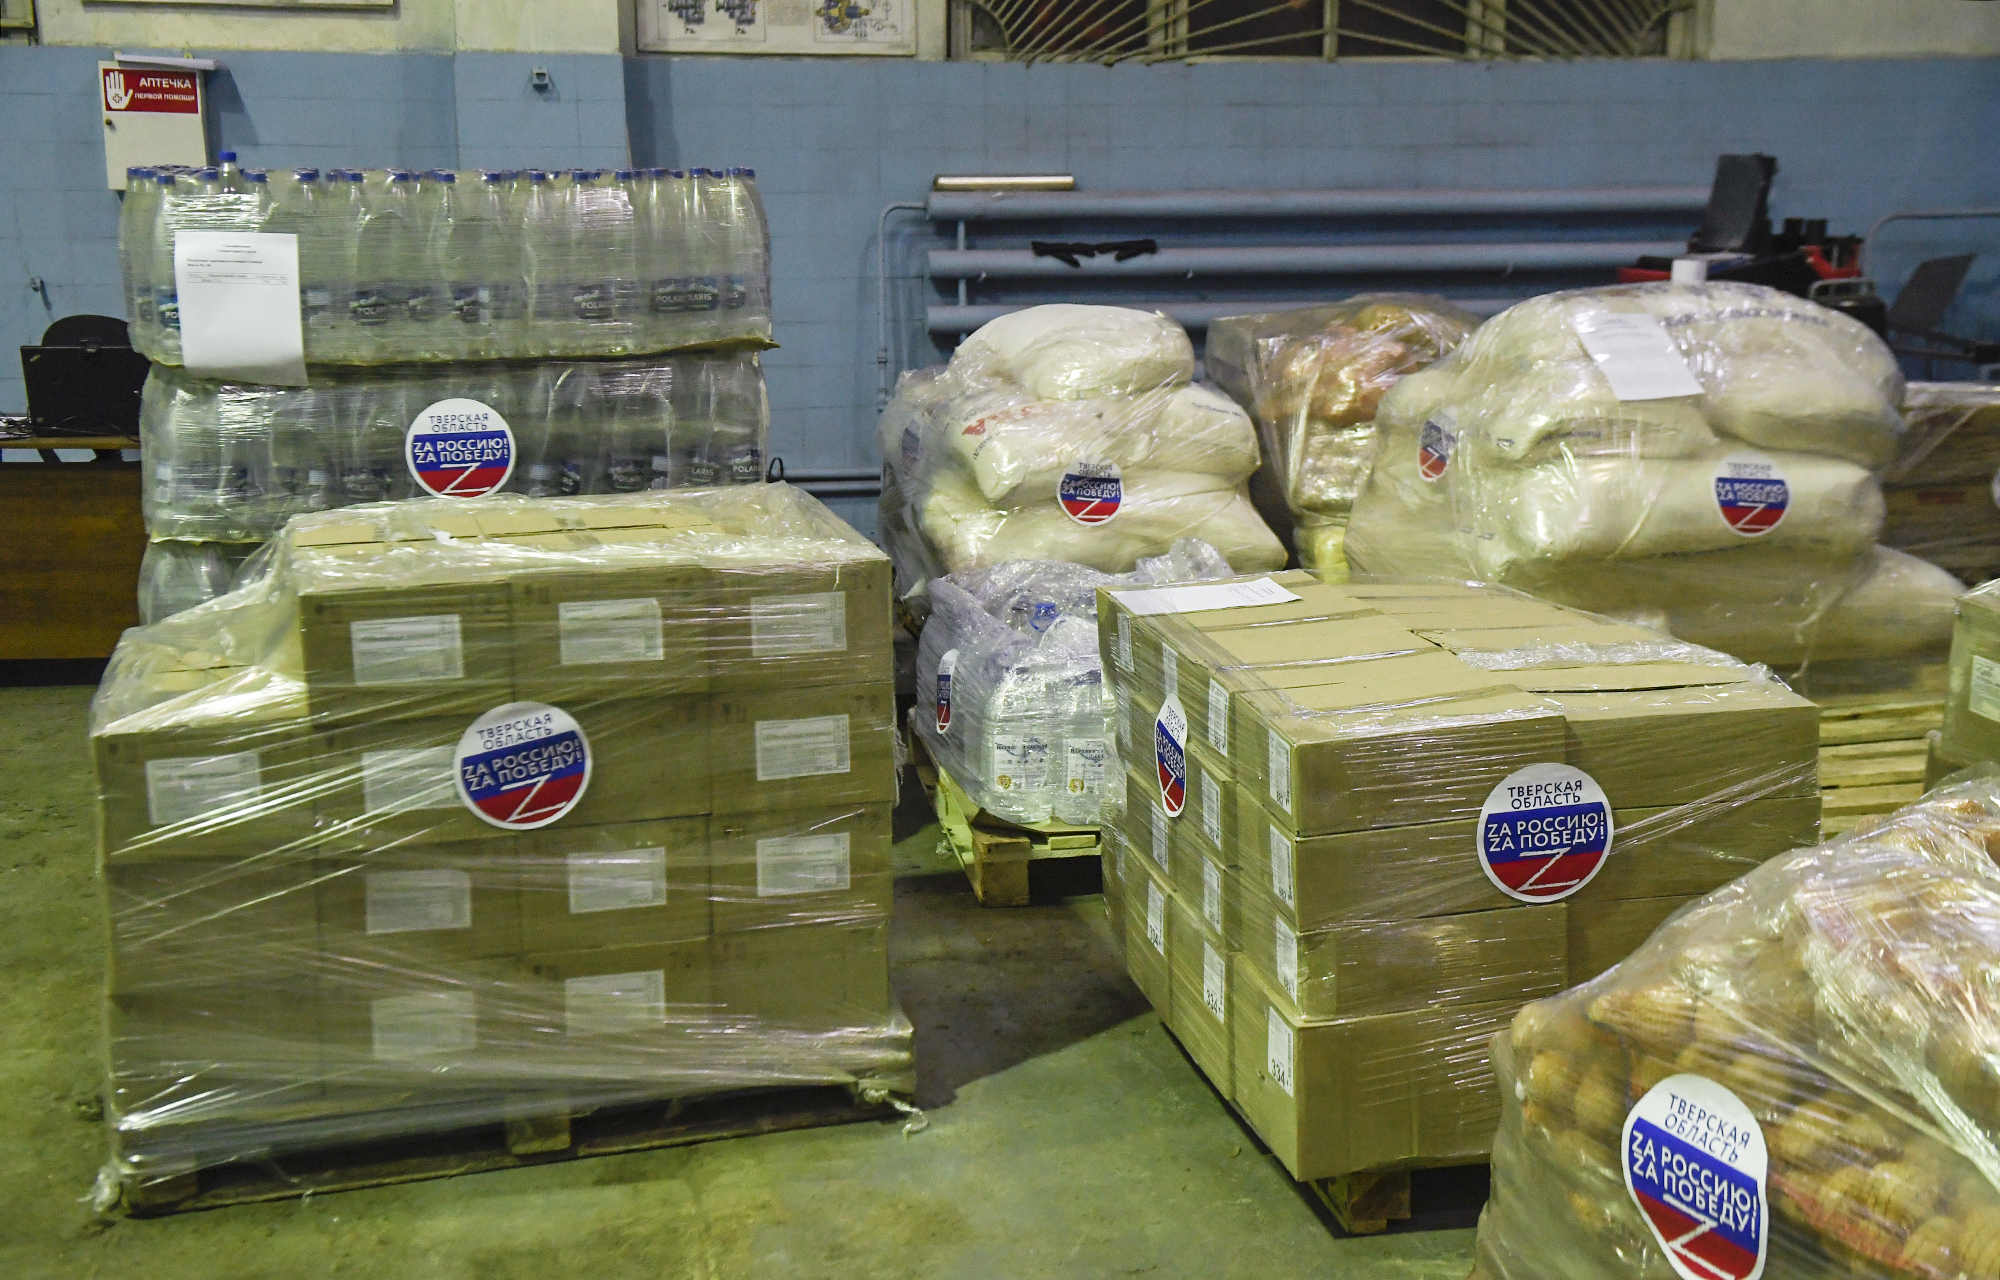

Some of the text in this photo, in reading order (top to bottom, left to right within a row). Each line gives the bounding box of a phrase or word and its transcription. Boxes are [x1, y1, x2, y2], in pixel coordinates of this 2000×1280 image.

[140, 78, 192, 88] АПТЕЧКА
[428, 413, 488, 424] ТВЕРСКАЯ
[432, 422, 488, 432] ОБЛАСТЬ
[414, 438, 508, 453] ZA РОССИЮ!
[415, 448, 508, 463] ZA ПОБЕДУ!
[1062, 486, 1120, 498] ZA ПОБЕДУ!
[1076, 481, 1119, 491] РОССИЮ!
[476, 713, 552, 740] ТВЕРСКАЯ
[483, 726, 553, 750] ОБЛАСТЬ
[1157, 728, 1163, 744] ZA
[462, 739, 580, 779] ZA РОССИЮ!
[467, 775, 496, 791] ZA
[498, 751, 583, 783] ПОБЕДУ!
[1507, 780, 1582, 798] ТВЕРСКАЯ
[1511, 792, 1581, 810] ОБЛАСТЬ
[1488, 811, 1604, 838] ZA РОССИЮ!
[1490, 826, 1604, 852] ZA ПОБЕДУ!
[1272, 1059, 1285, 1087] 334
[1669, 1093, 1750, 1148] ТВЕРСКАЯ
[1664, 1113, 1738, 1163] ОБЛАСТЬ
[1632, 1130, 1757, 1216] ZA РОССИЮ!
[1633, 1153, 1756, 1239] ZA ПОБЕДУ!
